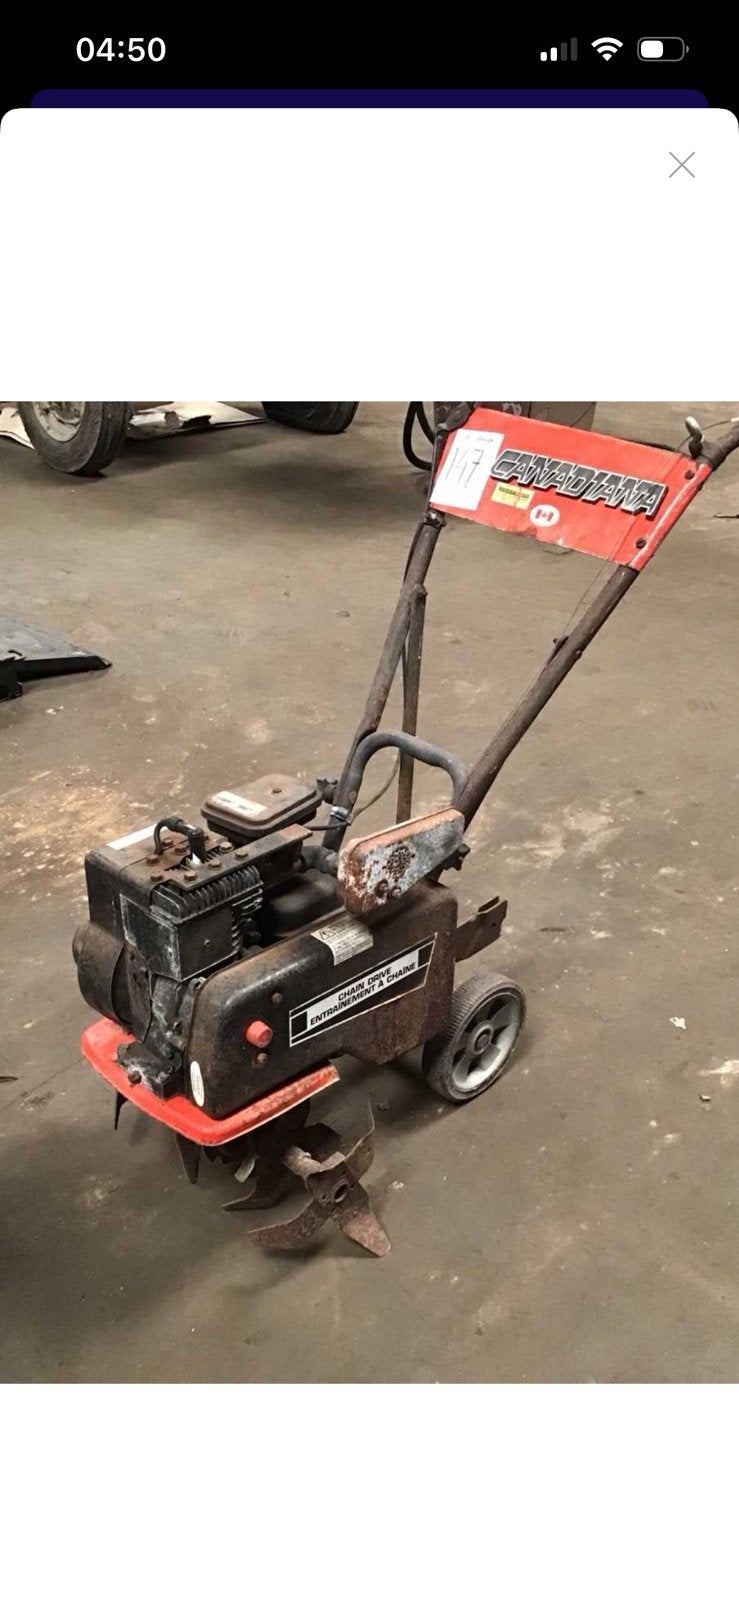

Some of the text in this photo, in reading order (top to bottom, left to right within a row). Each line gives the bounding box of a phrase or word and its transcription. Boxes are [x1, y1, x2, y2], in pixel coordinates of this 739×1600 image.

[445, 447, 485, 489] 147
[490, 450, 667, 516] CANADIANA
[338, 967, 391, 1001] CHAIN DRIVE
